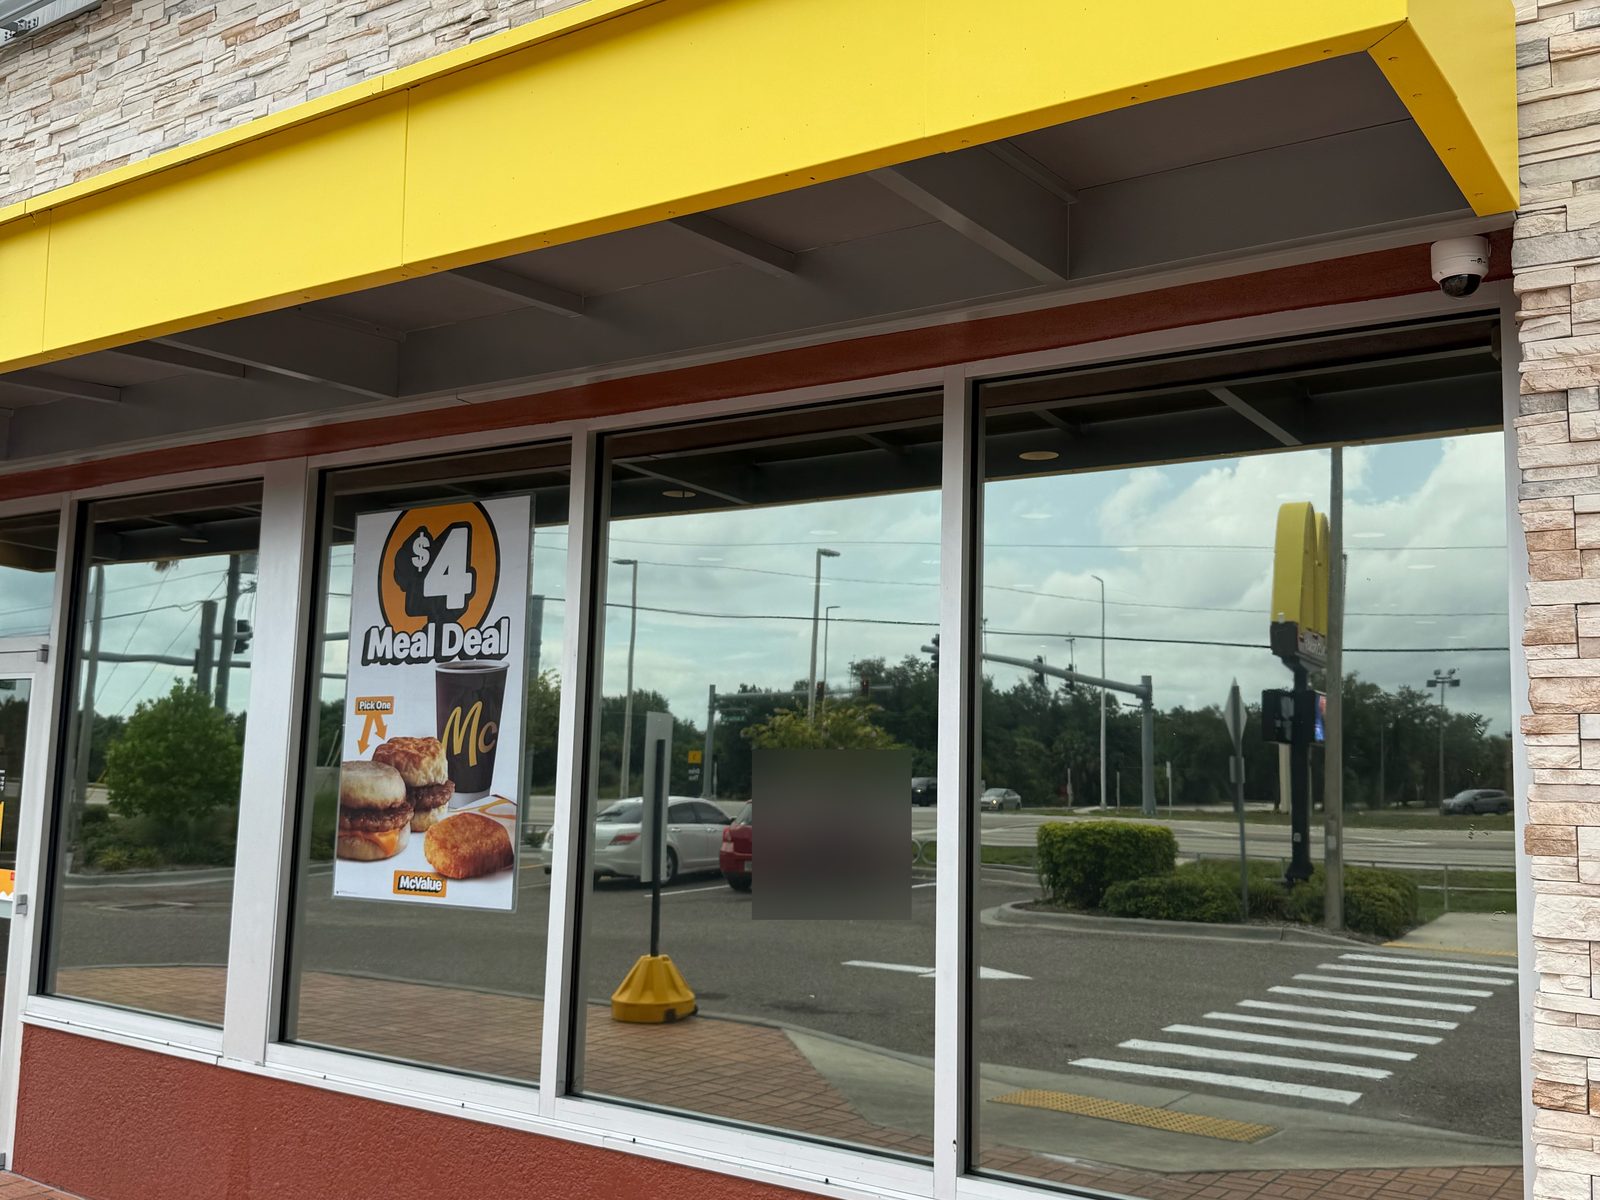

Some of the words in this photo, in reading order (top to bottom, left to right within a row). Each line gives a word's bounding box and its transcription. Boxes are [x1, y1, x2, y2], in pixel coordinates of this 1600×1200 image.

[411, 526, 473, 610] $4
[364, 622, 436, 661] Meal
[440, 617, 510, 658] Deal
[359, 701, 376, 710] Pick
[376, 700, 391, 710] One
[441, 700, 498, 768] Mc
[398, 875, 443, 892] McValue
